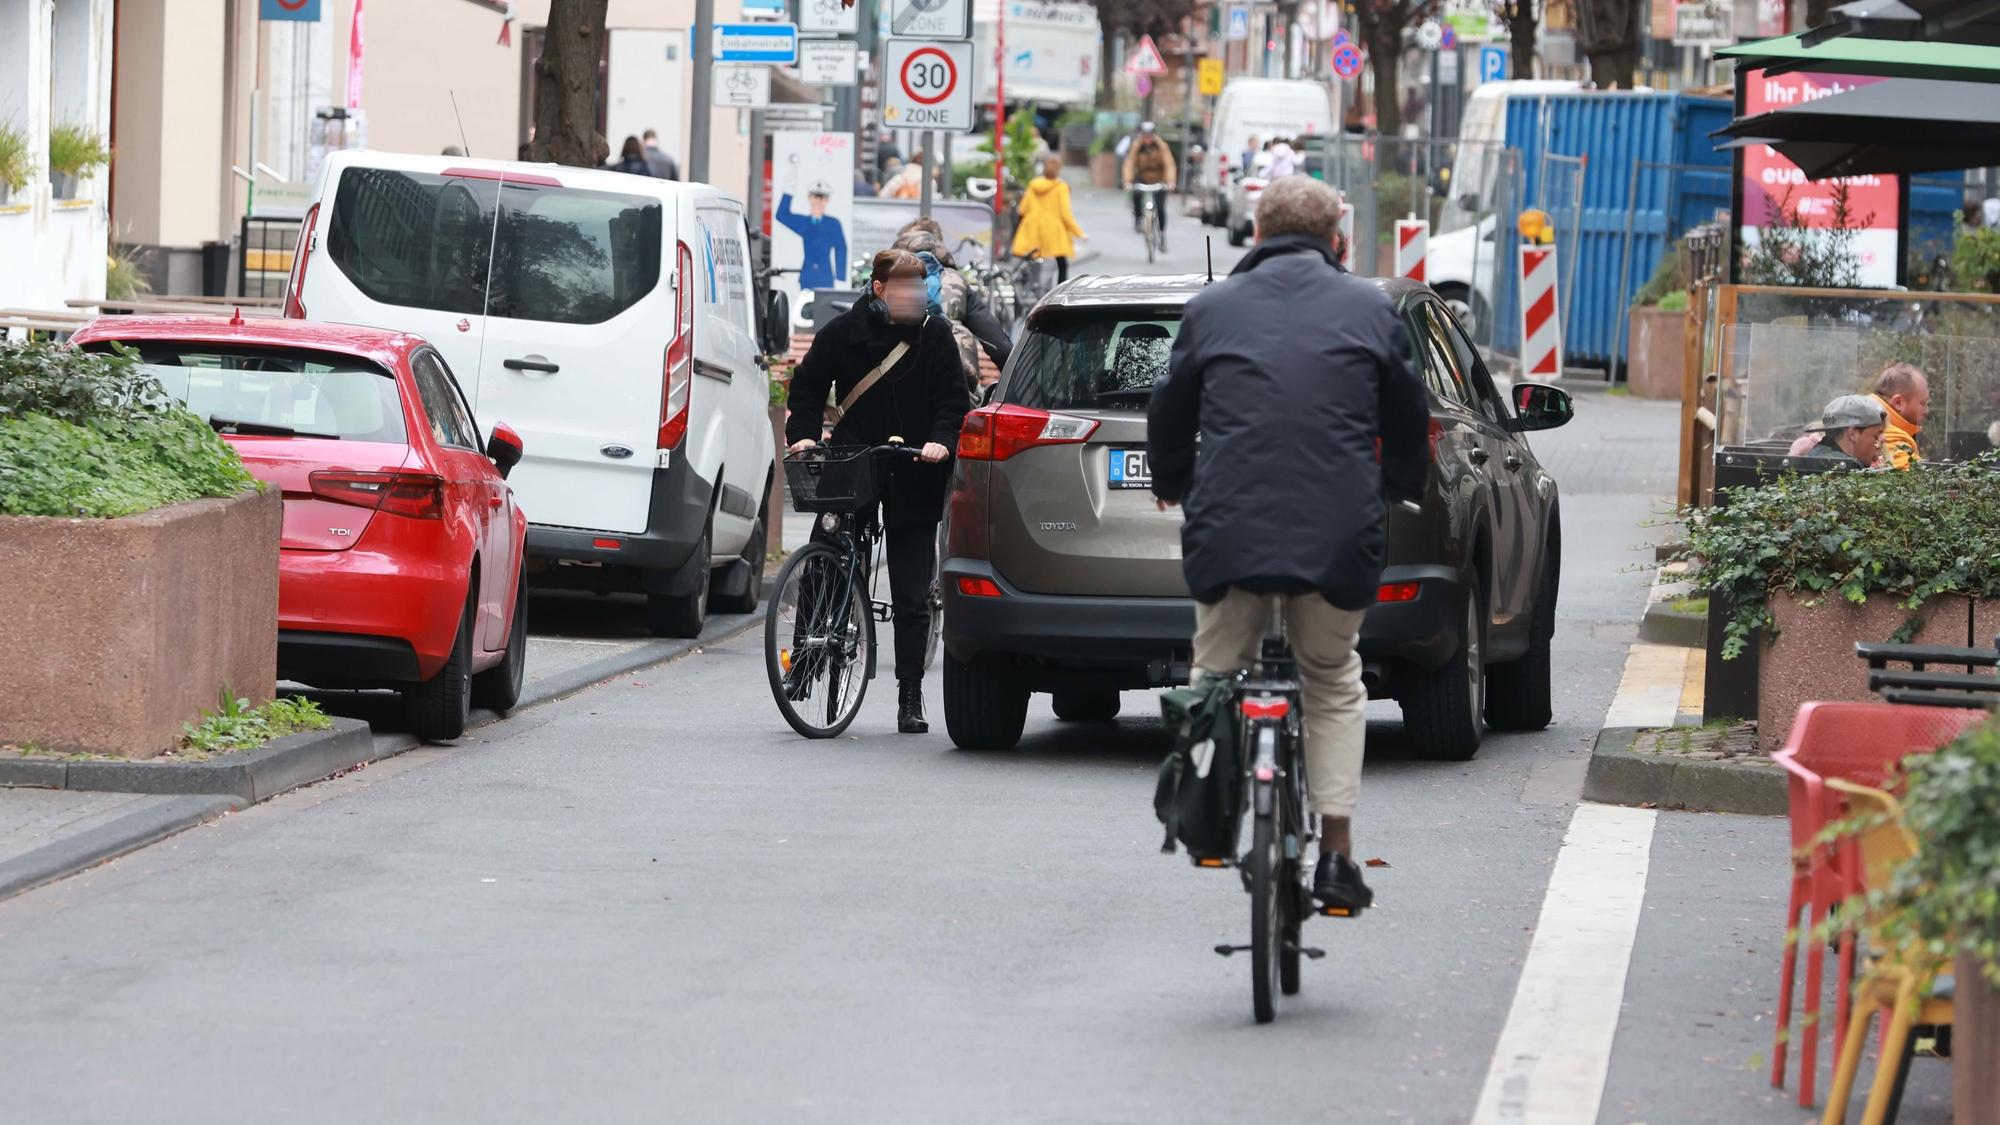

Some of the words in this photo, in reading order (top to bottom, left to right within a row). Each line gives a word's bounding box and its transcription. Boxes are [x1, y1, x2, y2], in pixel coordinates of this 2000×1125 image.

[909, 17, 946, 31] ZONE
[720, 39, 790, 49] Einbahnstraße
[912, 63, 945, 89] 30
[1764, 81, 1798, 103] Ihr
[905, 108, 950, 123] ZONE
[1762, 167, 1813, 185] eue
[1113, 468, 1120, 476] D
[1125, 454, 1152, 478] GL
[328, 527, 350, 536] TDI
[1039, 521, 1077, 531] TOYOTA
